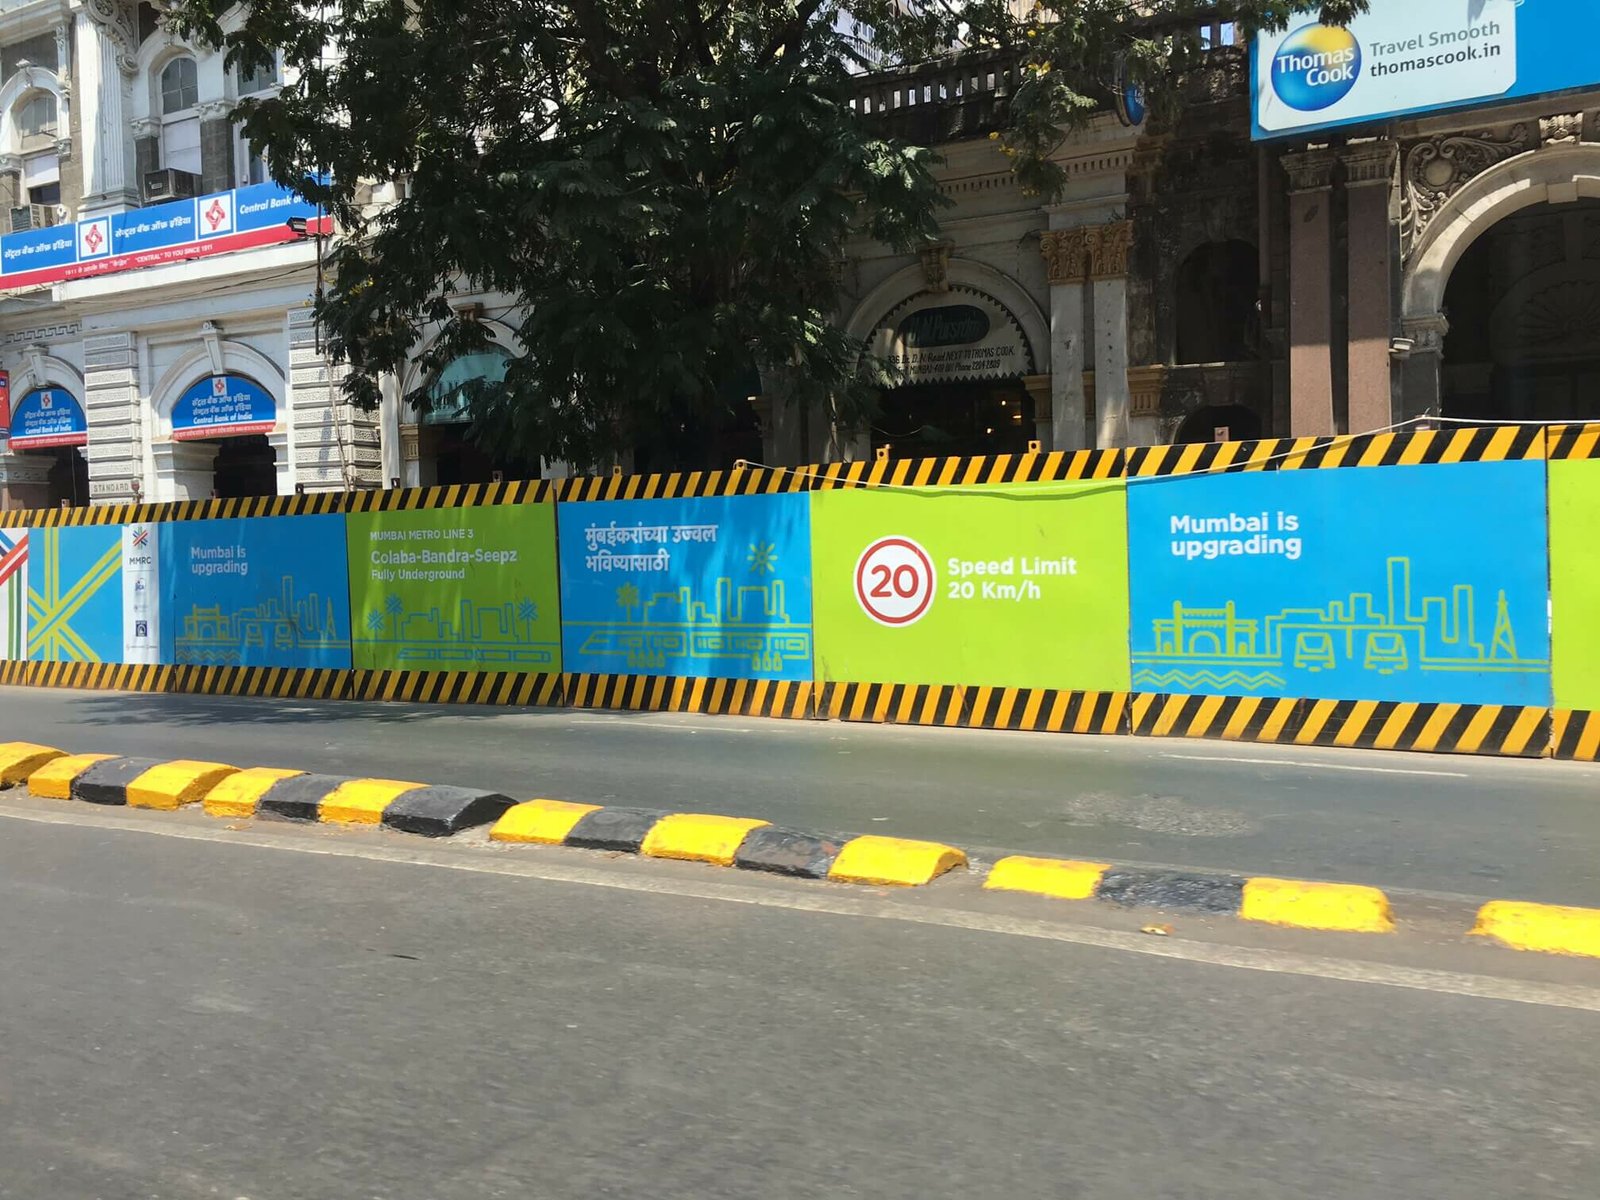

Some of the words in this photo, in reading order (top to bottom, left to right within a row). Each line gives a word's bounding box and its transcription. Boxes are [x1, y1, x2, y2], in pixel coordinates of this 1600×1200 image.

[1370, 35, 1424, 57] Travel
[1429, 21, 1500, 46] Smooth
[1277, 46, 1354, 74] Thomas
[1370, 43, 1501, 77] thomascook.in
[1306, 64, 1354, 87] Cook
[240, 200, 268, 214] Central
[270, 196, 292, 208] Bank
[172, 249, 183, 257] YOU
[971, 347, 994, 358] THOMAS
[193, 415, 213, 424] Central
[215, 413, 229, 422] Bank
[230, 412, 237, 421] of
[238, 411, 253, 420] India
[25, 426, 41, 434] Central
[42, 425, 53, 434] Bank
[54, 424, 59, 432] of
[60, 424, 72, 432] India
[94, 483, 128, 492] STANDARD
[1170, 512, 1268, 534] Mumbai
[1277, 511, 1299, 531] is
[370, 530, 406, 540] MUMBAI
[409, 530, 440, 539] METRO
[443, 529, 465, 539] LINE
[467, 529, 474, 538] 3
[585, 520, 668, 550] मुंबईकरांच्या
[191, 546, 234, 559] Mumbai
[237, 545, 246, 557] is
[1171, 534, 1302, 560] upgrading
[129, 556, 151, 565] MMRC
[371, 549, 517, 565] Colaba-Bandra-Seepz
[585, 548, 670, 572] भविष्यासाठी
[192, 561, 248, 576] upgrading
[371, 569, 395, 582] Fully
[398, 568, 465, 582] Underground
[948, 557, 1014, 578] Speed
[1021, 557, 1077, 575] Limit
[870, 564, 919, 598] 20
[948, 581, 975, 599] 20
[982, 580, 1041, 602] Km/h
